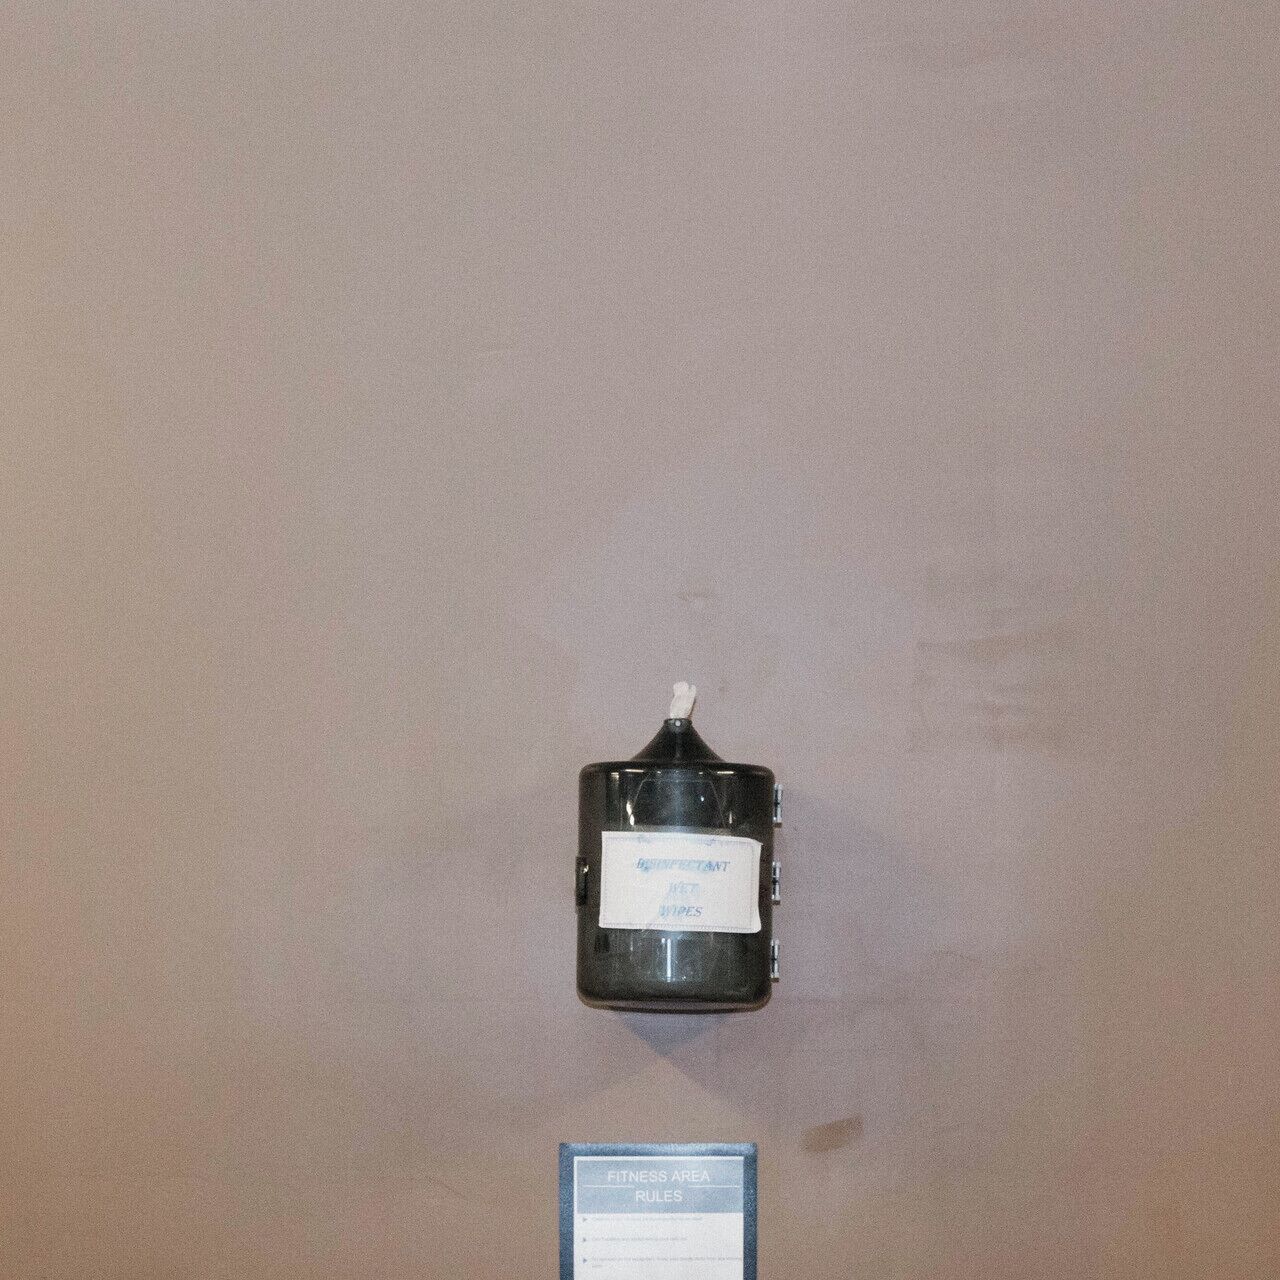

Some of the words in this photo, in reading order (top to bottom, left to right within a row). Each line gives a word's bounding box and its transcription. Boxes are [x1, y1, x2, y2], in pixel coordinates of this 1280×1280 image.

[659, 905, 703, 917] WIPES
[608, 1170, 667, 1182] FITNESS
[671, 1170, 710, 1182] AREA
[636, 1190, 683, 1202] RULES
